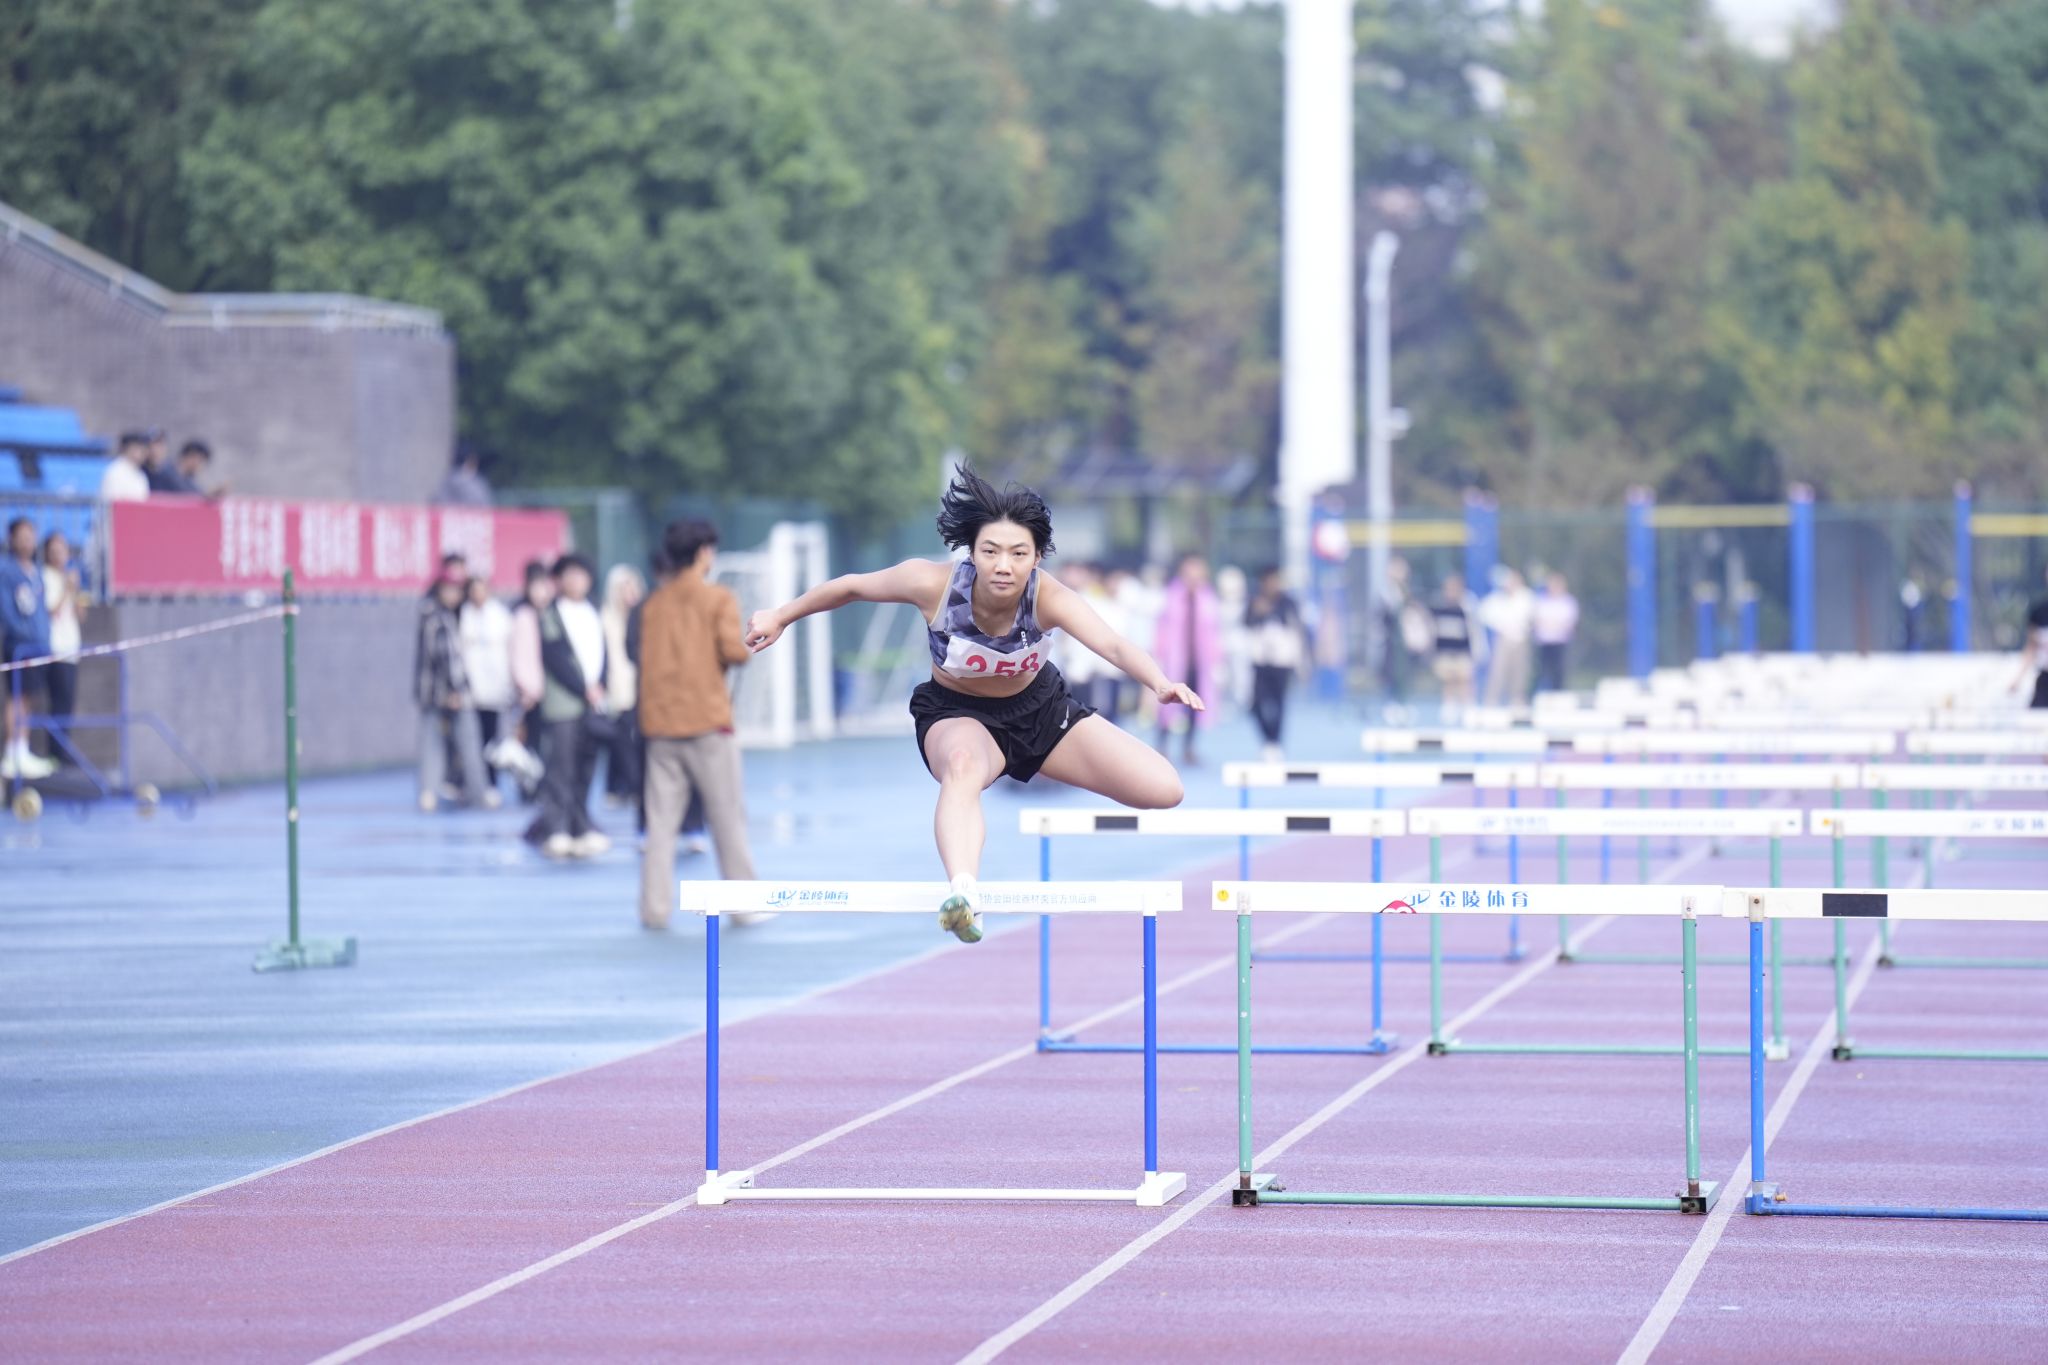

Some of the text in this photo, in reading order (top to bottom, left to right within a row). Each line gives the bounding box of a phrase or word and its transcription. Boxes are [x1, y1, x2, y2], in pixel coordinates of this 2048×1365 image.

[799, 890, 848, 901] 金陵体育
[1439, 890, 1528, 908] 金陵体育
